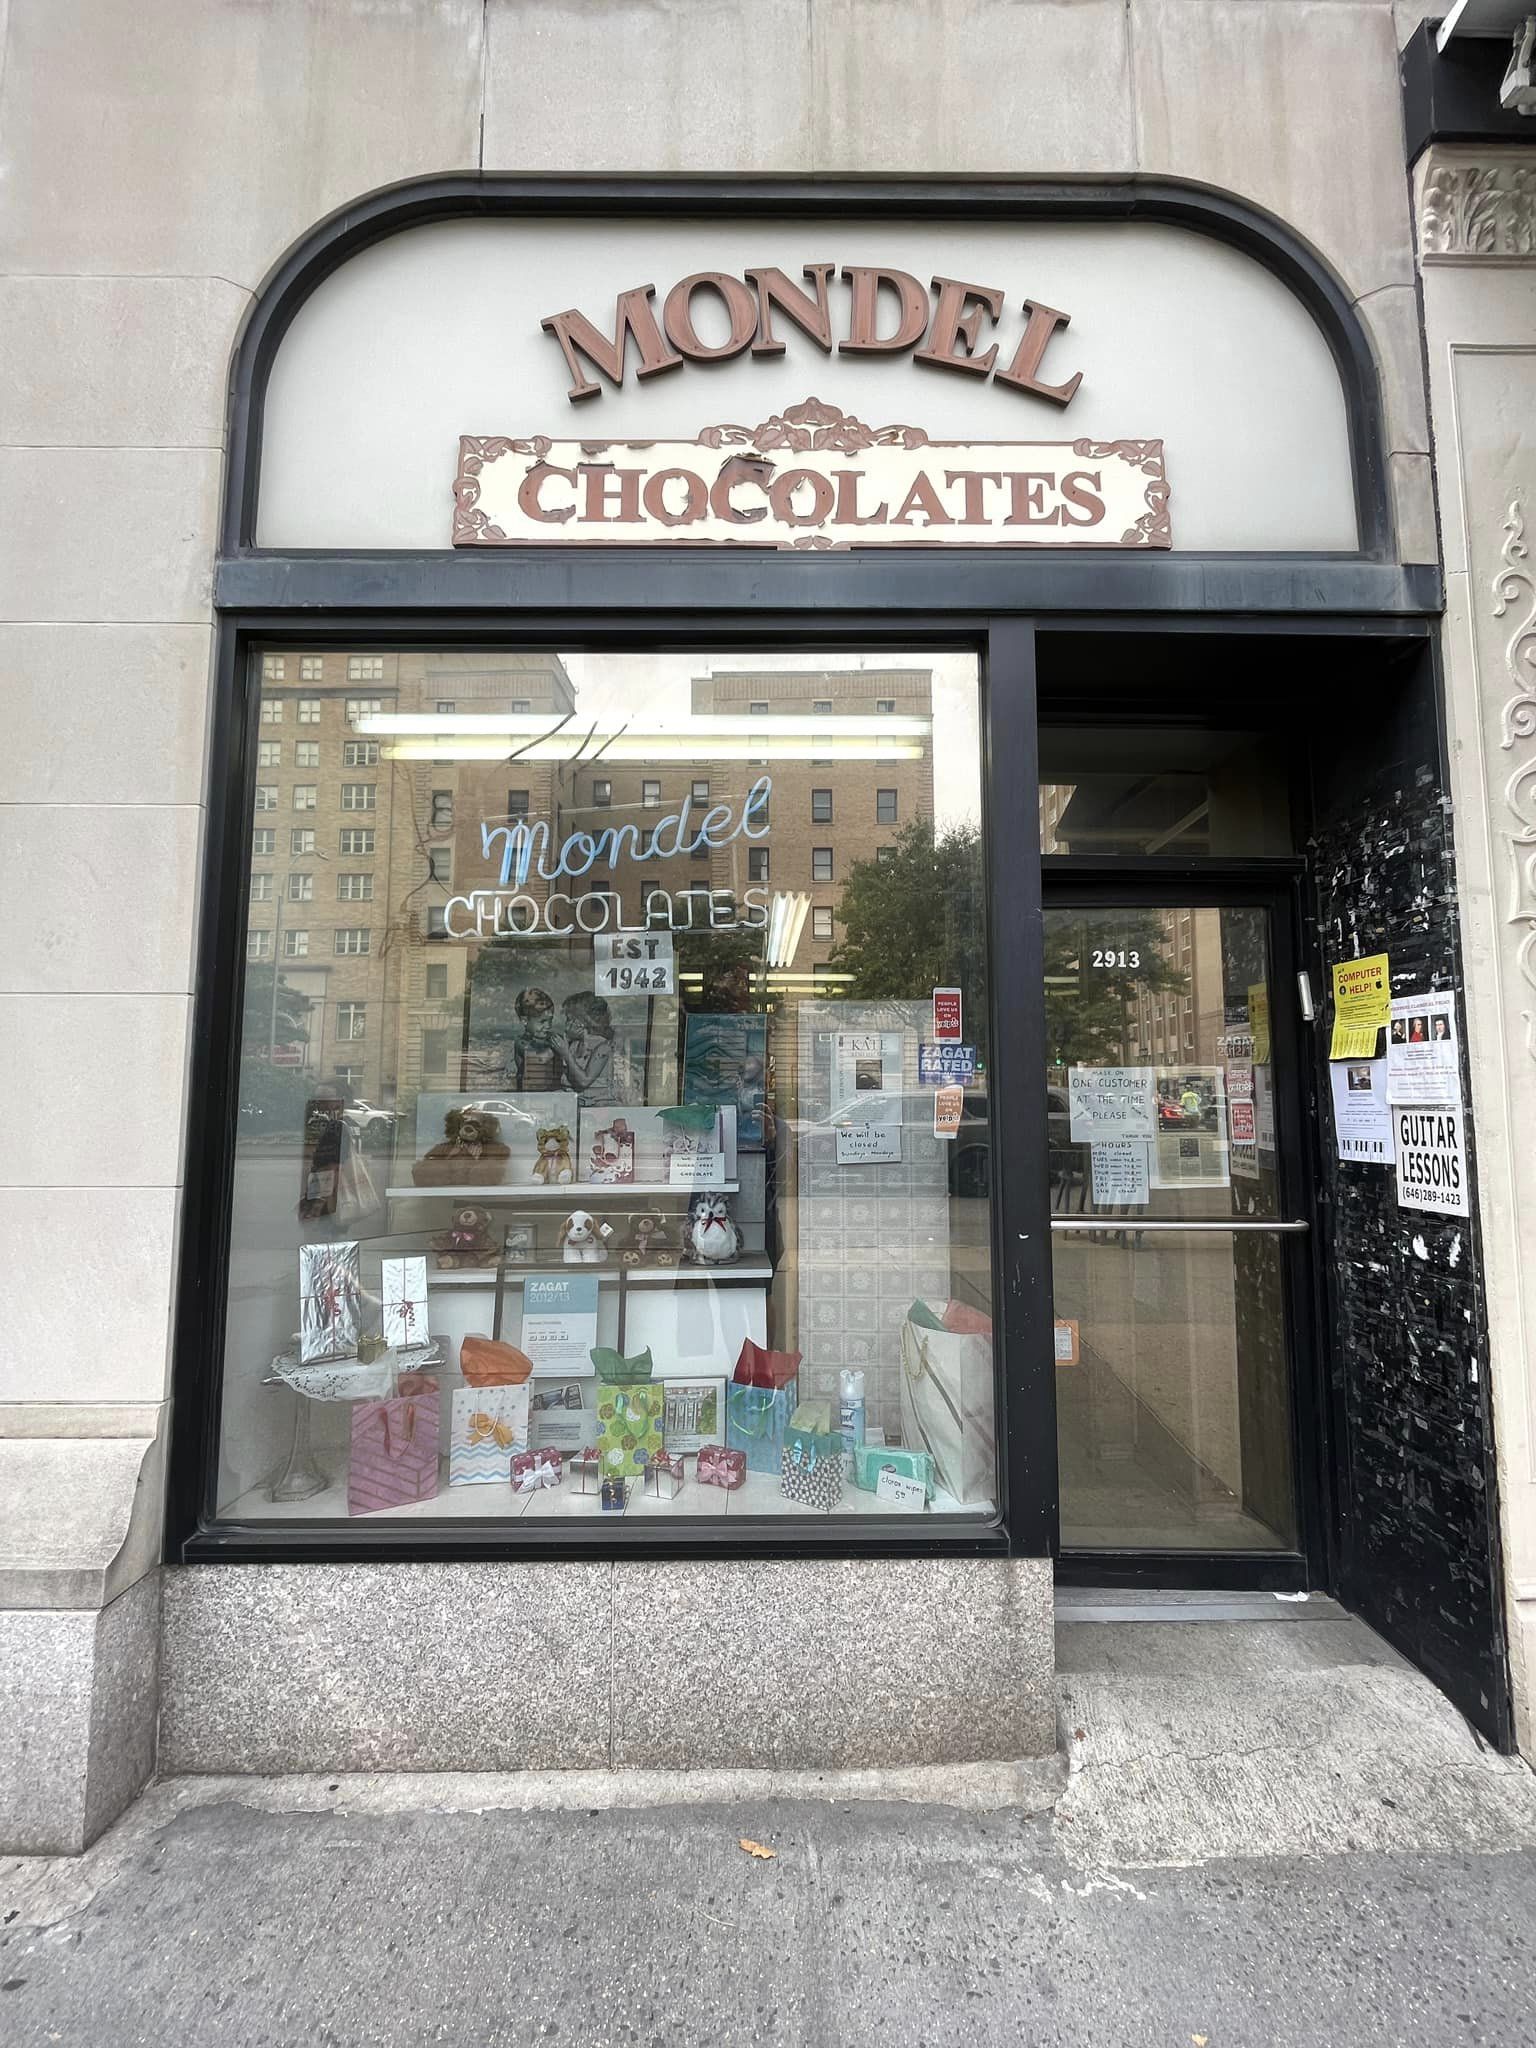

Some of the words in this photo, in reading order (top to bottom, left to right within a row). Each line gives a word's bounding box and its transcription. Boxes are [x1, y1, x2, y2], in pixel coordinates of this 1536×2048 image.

[540, 262, 1084, 410] MONDEL
[517, 460, 1106, 528] CHOCOLATES
[444, 887, 769, 938] CHOCOLATES
[612, 938, 660, 960] EST
[1092, 950, 1141, 968] 2913
[606, 967, 668, 990] 1942
[1338, 966, 1382, 984] COMPUTER
[1349, 984, 1372, 995] HELP!
[937, 1020, 952, 1029] yelp
[1216, 1036, 1256, 1046] ZAGAT
[921, 1047, 973, 1059] ZAGAT
[921, 1059, 973, 1071] RATED
[1072, 1079, 1092, 1088] ONE
[1098, 1078, 1148, 1088] CUSTOMER
[1076, 1095, 1089, 1104] AT
[1097, 1094, 1114, 1104] THE
[1120, 1095, 1145, 1104] TIME
[938, 1115, 953, 1123] yelp
[1092, 1111, 1127, 1119] PLEASE
[856, 1130, 869, 1138] will
[874, 1130, 886, 1138] be
[1400, 1114, 1458, 1149] GUITAR
[1402, 1151, 1460, 1189] LESSONS
[1402, 1185, 1461, 1206] (646)289-1423
[530, 1281, 569, 1292] ZAGAT
[529, 1291, 570, 1303] 2012/13
